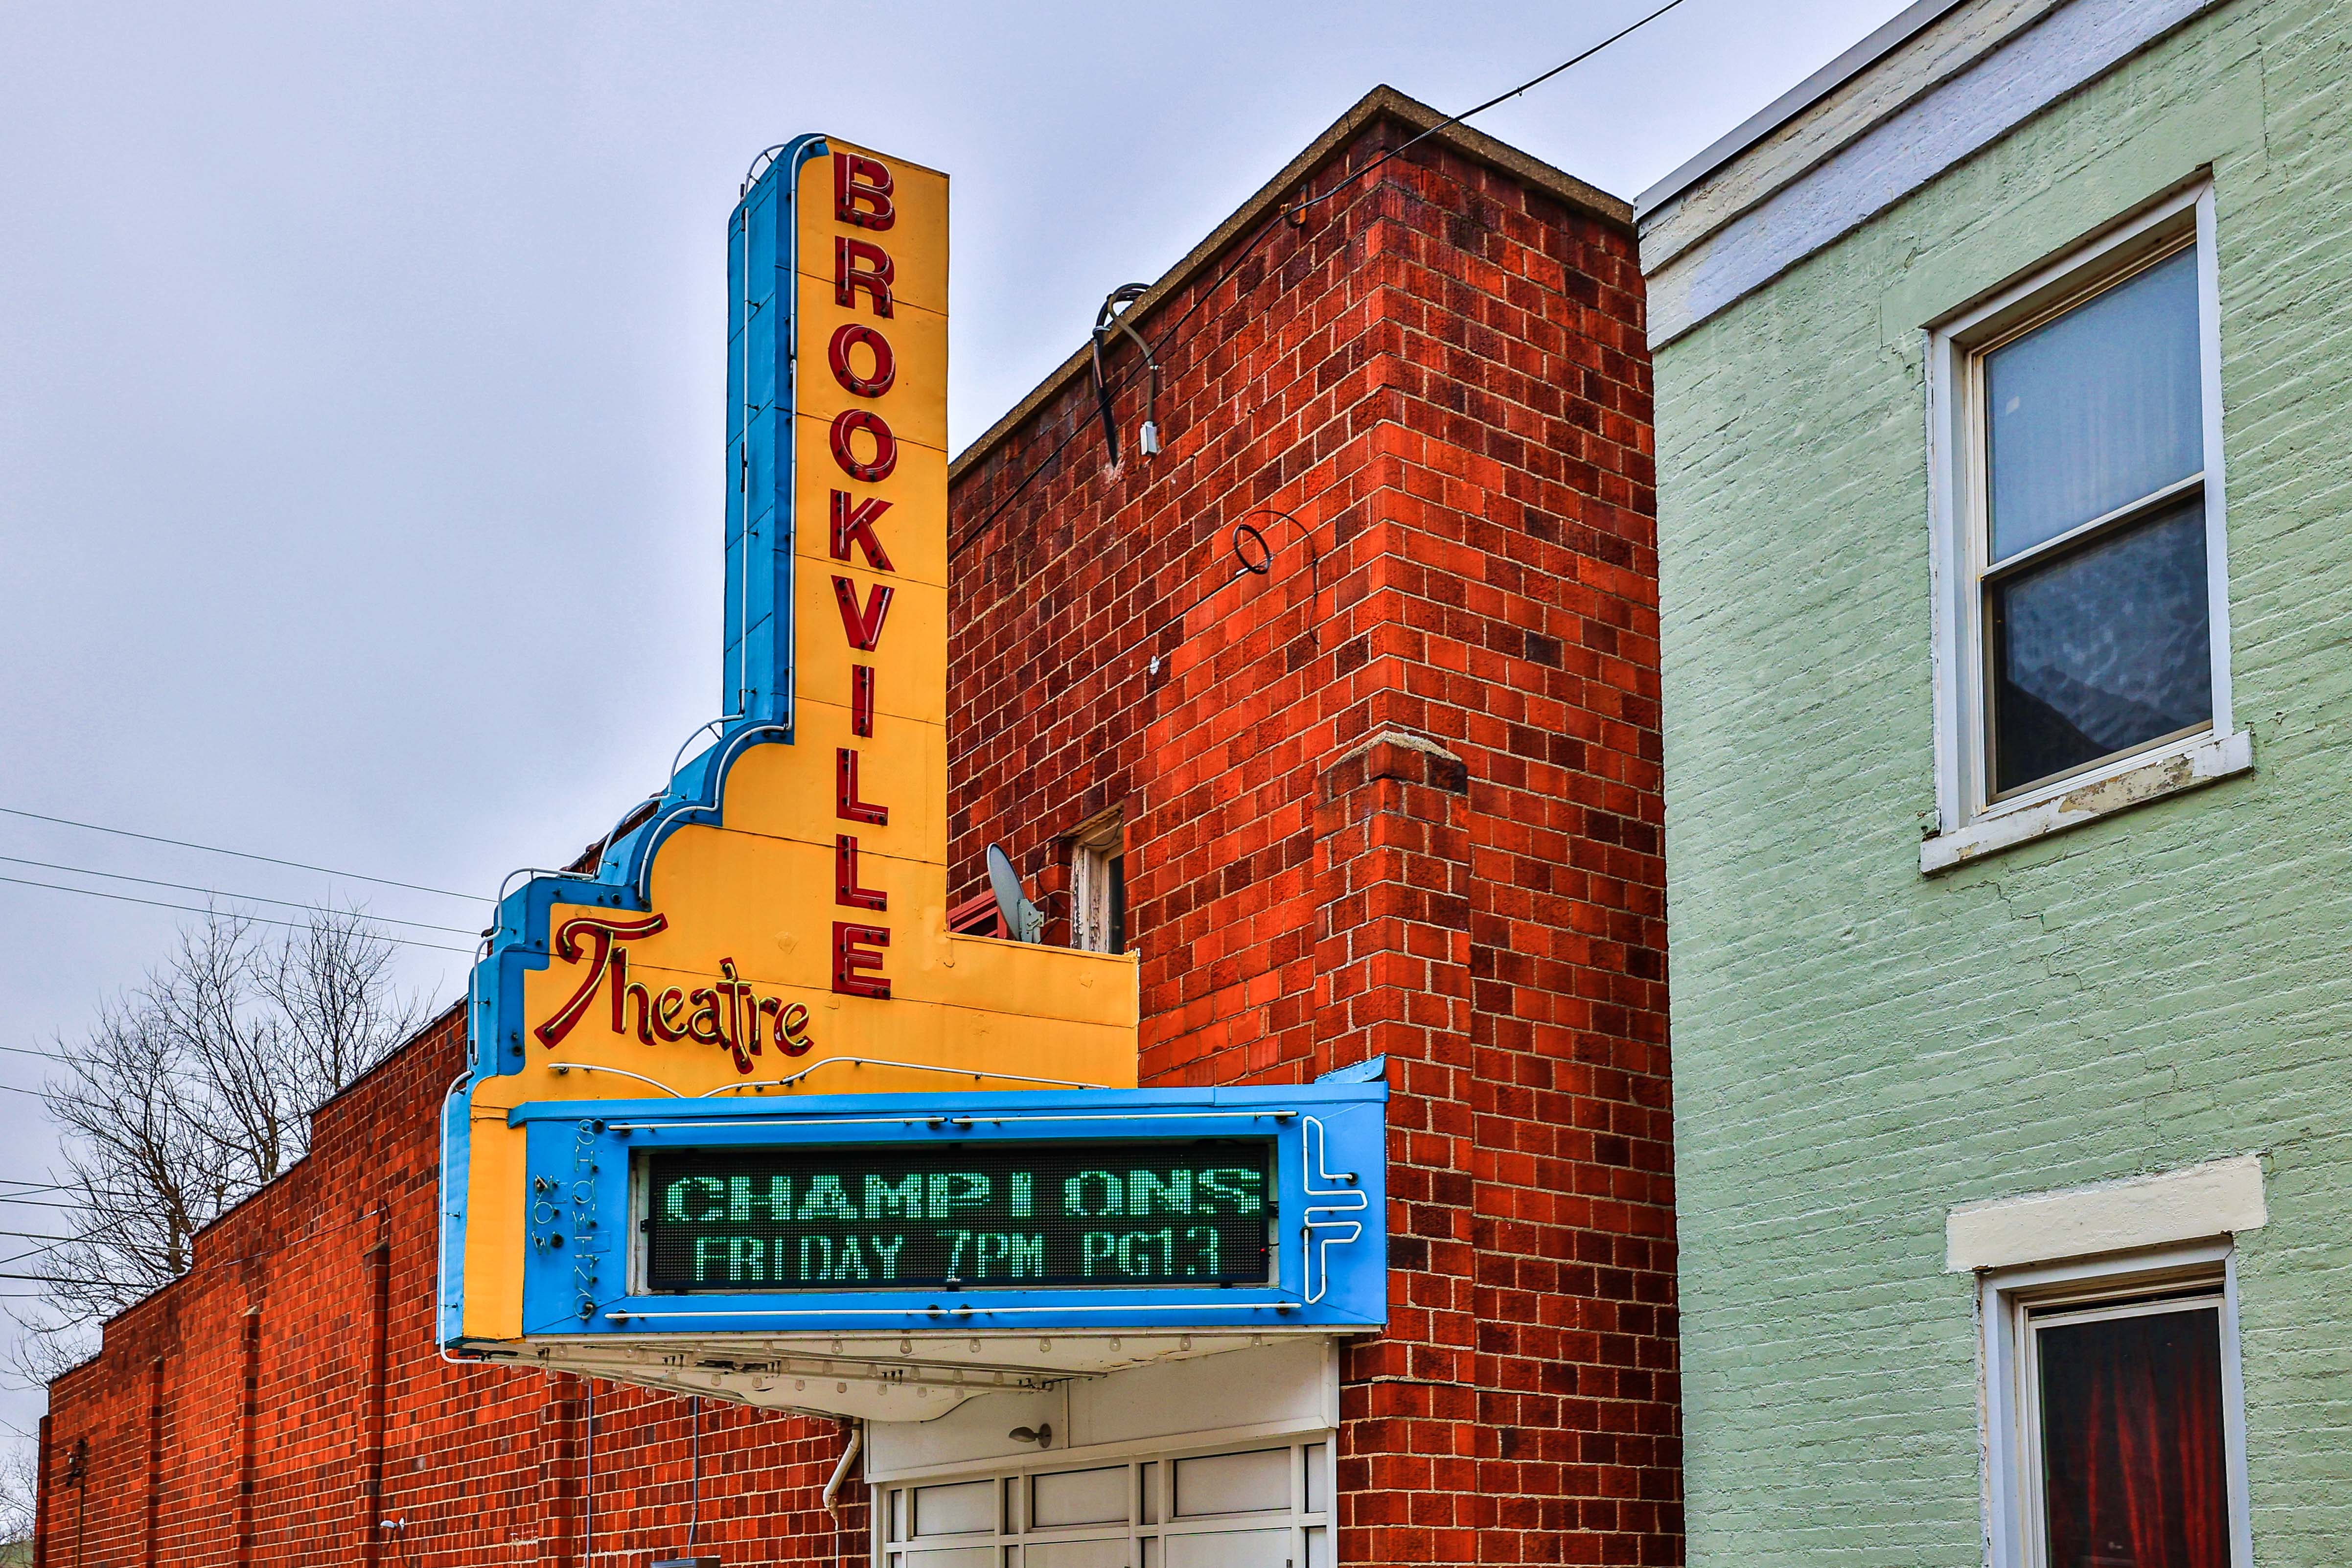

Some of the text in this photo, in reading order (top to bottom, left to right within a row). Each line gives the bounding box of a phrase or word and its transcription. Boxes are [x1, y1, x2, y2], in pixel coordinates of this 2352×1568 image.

[828, 151, 897, 1001] BROOKVILLE
[533, 912, 814, 1075] Theatre
[667, 1169, 1261, 1221] CHAMPIONS
[695, 1234, 903, 1281] FRIDAY
[936, 1229, 1044, 1279] 7PM
